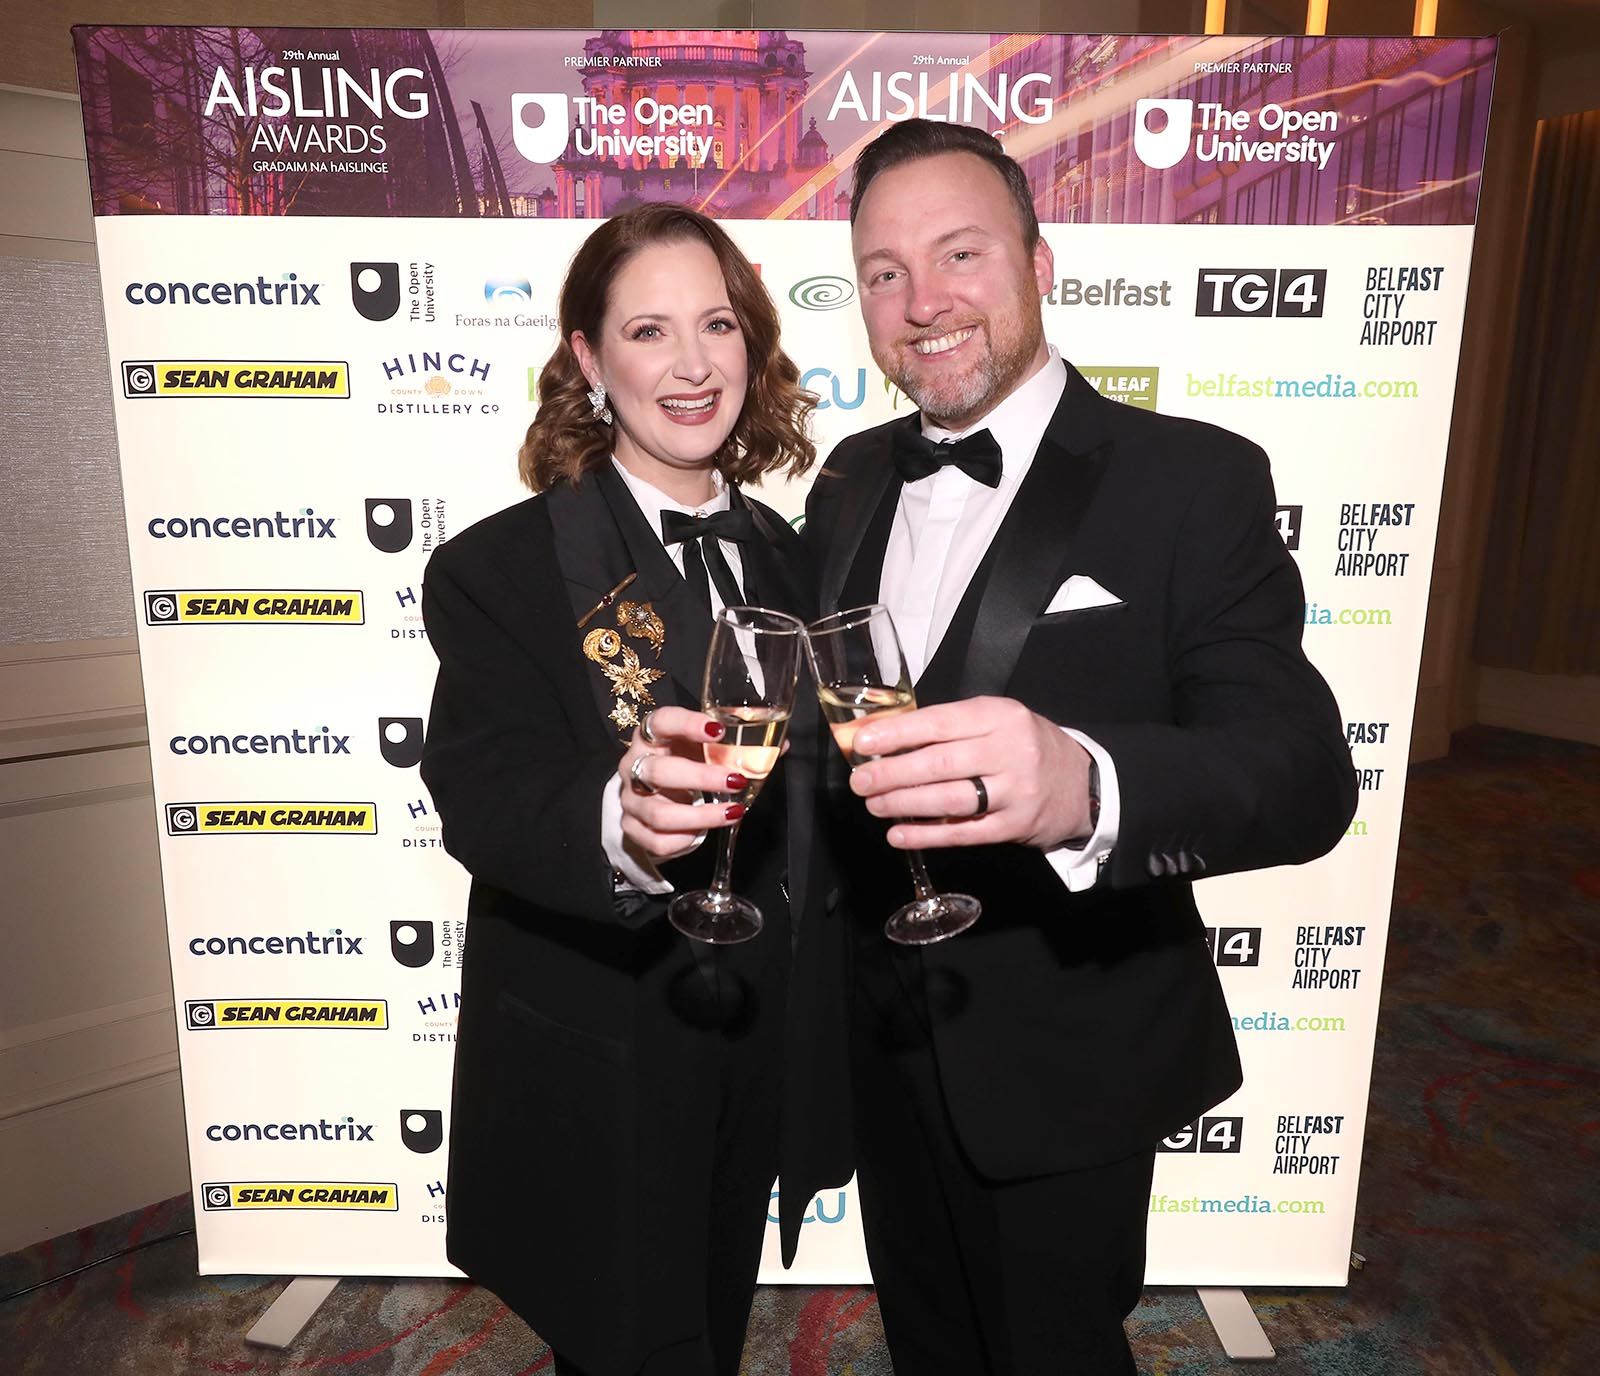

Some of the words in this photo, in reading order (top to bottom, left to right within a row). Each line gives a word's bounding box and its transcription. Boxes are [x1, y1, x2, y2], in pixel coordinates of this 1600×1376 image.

[282, 50, 304, 61] 29th
[307, 50, 340, 61] Annual
[564, 56, 611, 67] PREMIER
[613, 56, 663, 67] PARTNER
[912, 55, 934, 66] 29th
[937, 55, 970, 66] Annual
[1194, 62, 1241, 73] PREMIER
[1243, 62, 1293, 74] PARTNER
[203, 65, 430, 120] AISLING
[826, 70, 1054, 125] AISLING
[572, 96, 627, 126] The
[634, 96, 714, 133] Open
[1197, 102, 1251, 132] The
[1258, 103, 1338, 139] Open
[251, 123, 388, 155] AWARDS
[574, 128, 714, 164] University
[1195, 134, 1336, 170] University
[253, 160, 308, 173] GRADAIM
[310, 161, 329, 173] NA
[331, 160, 389, 174] hAISLINGE
[124, 272, 322, 305] concentrix
[408, 262, 421, 295] Open
[1365, 266, 1444, 291] BELFAST
[423, 262, 436, 323] University
[409, 301, 420, 322] The
[1363, 293, 1406, 319] CITY
[455, 313, 491, 327] Foras
[494, 317, 511, 327] na
[1360, 320, 1438, 346] AIRPORT
[382, 351, 491, 382] HINCH
[163, 370, 230, 388] SEAN
[233, 370, 338, 389] GRAHAM
[1106, 376, 1151, 392] LEAF
[1185, 373, 1419, 399] belfastmedia.com
[391, 388, 423, 396] COUNTY
[377, 403, 473, 414] DISTILLERY
[147, 508, 337, 539] concentrix
[421, 498, 433, 529] Open
[1339, 503, 1416, 526] BELFAST
[422, 532, 432, 554] The
[1337, 528, 1379, 552] CITY
[1334, 553, 1410, 577] AIRPORT
[185, 598, 250, 616] SEAN
[252, 598, 354, 616] GRAHAM
[169, 725, 351, 755] concentrix
[204, 809, 266, 826] SEAN
[269, 809, 367, 827] GRAHAM
[189, 928, 363, 955] concentrix
[441, 920, 453, 947] Open
[1295, 926, 1366, 946] BELFAST
[442, 950, 452, 969] The
[1294, 947, 1332, 968] CITY
[1291, 969, 1361, 990] AIRPORT
[221, 1006, 282, 1021] SEAN
[284, 1006, 378, 1022] GRAHAM
[205, 1116, 375, 1142] concentrix
[1276, 1115, 1345, 1134] BELFAST
[1275, 1135, 1312, 1155] CITY
[1272, 1155, 1340, 1175] AIRPORT
[237, 1188, 294, 1203] SEAN
[297, 1188, 388, 1204] GRAHAM
